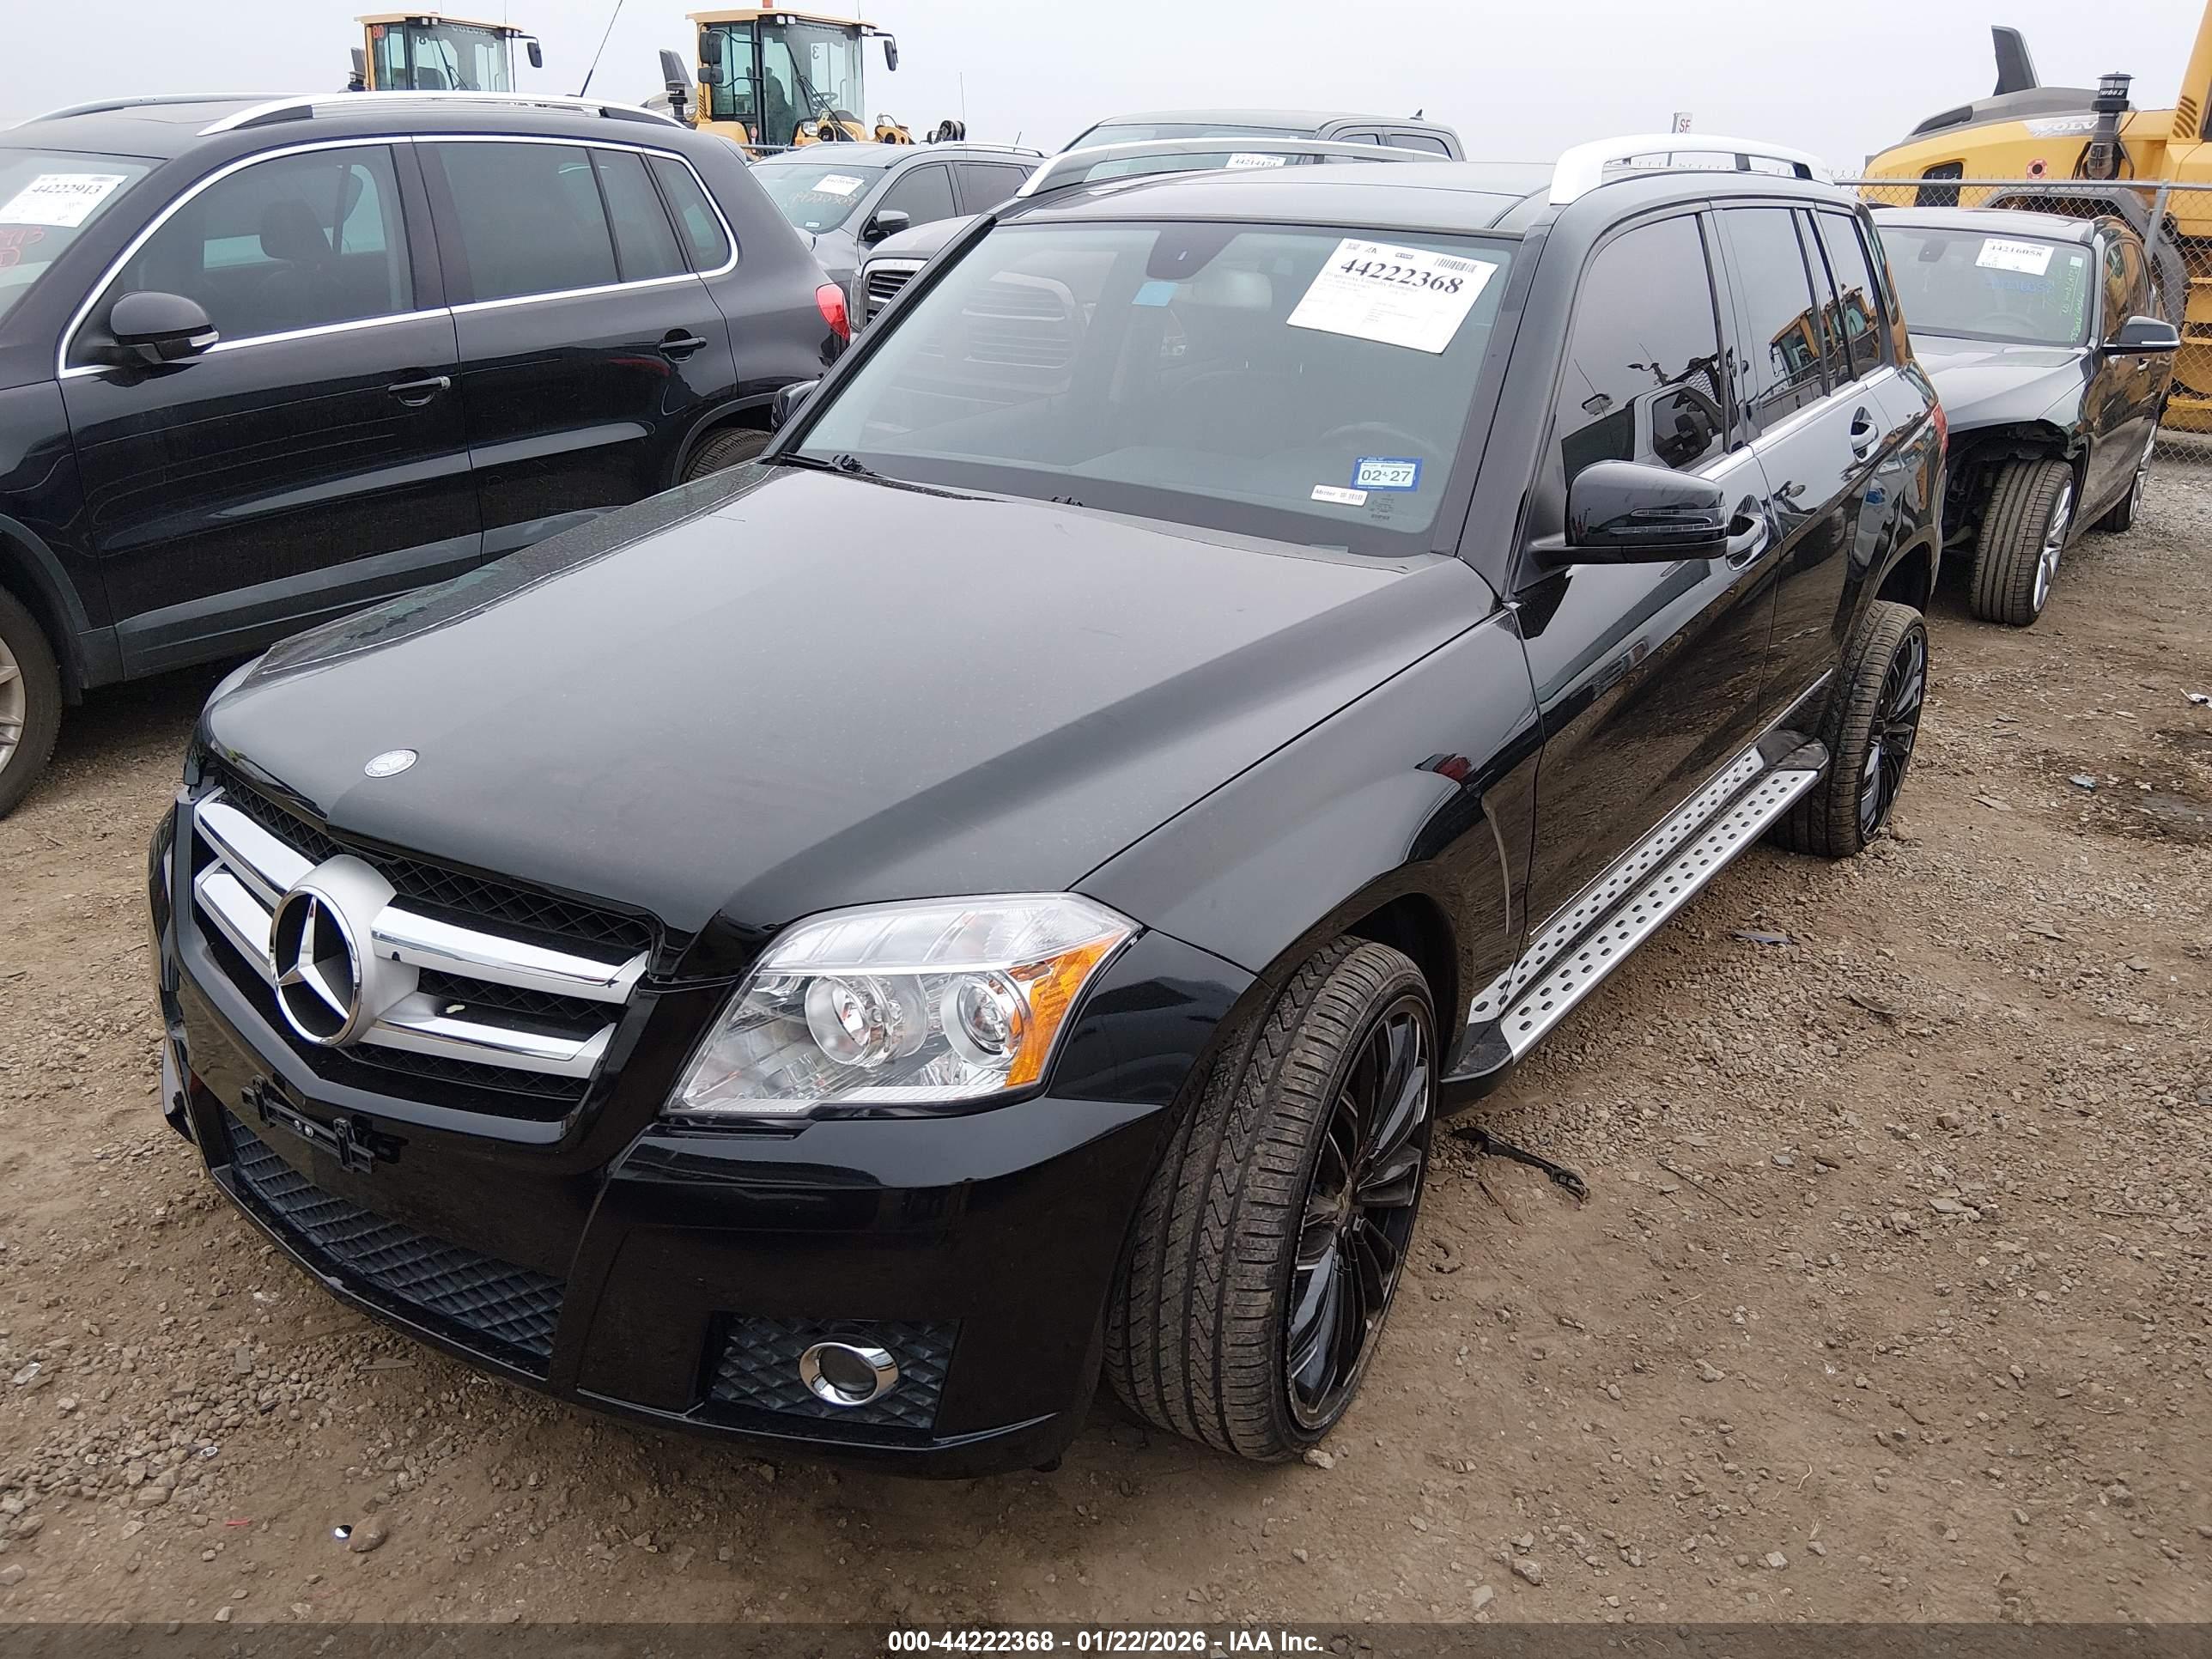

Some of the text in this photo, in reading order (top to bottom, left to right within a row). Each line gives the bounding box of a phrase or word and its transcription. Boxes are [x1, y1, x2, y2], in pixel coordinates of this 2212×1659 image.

[372, 25, 384, 39] 80
[32, 183, 103, 195] 44222913
[1340, 258, 1464, 294] 44222368
[1361, 469, 1411, 482] 02 27
